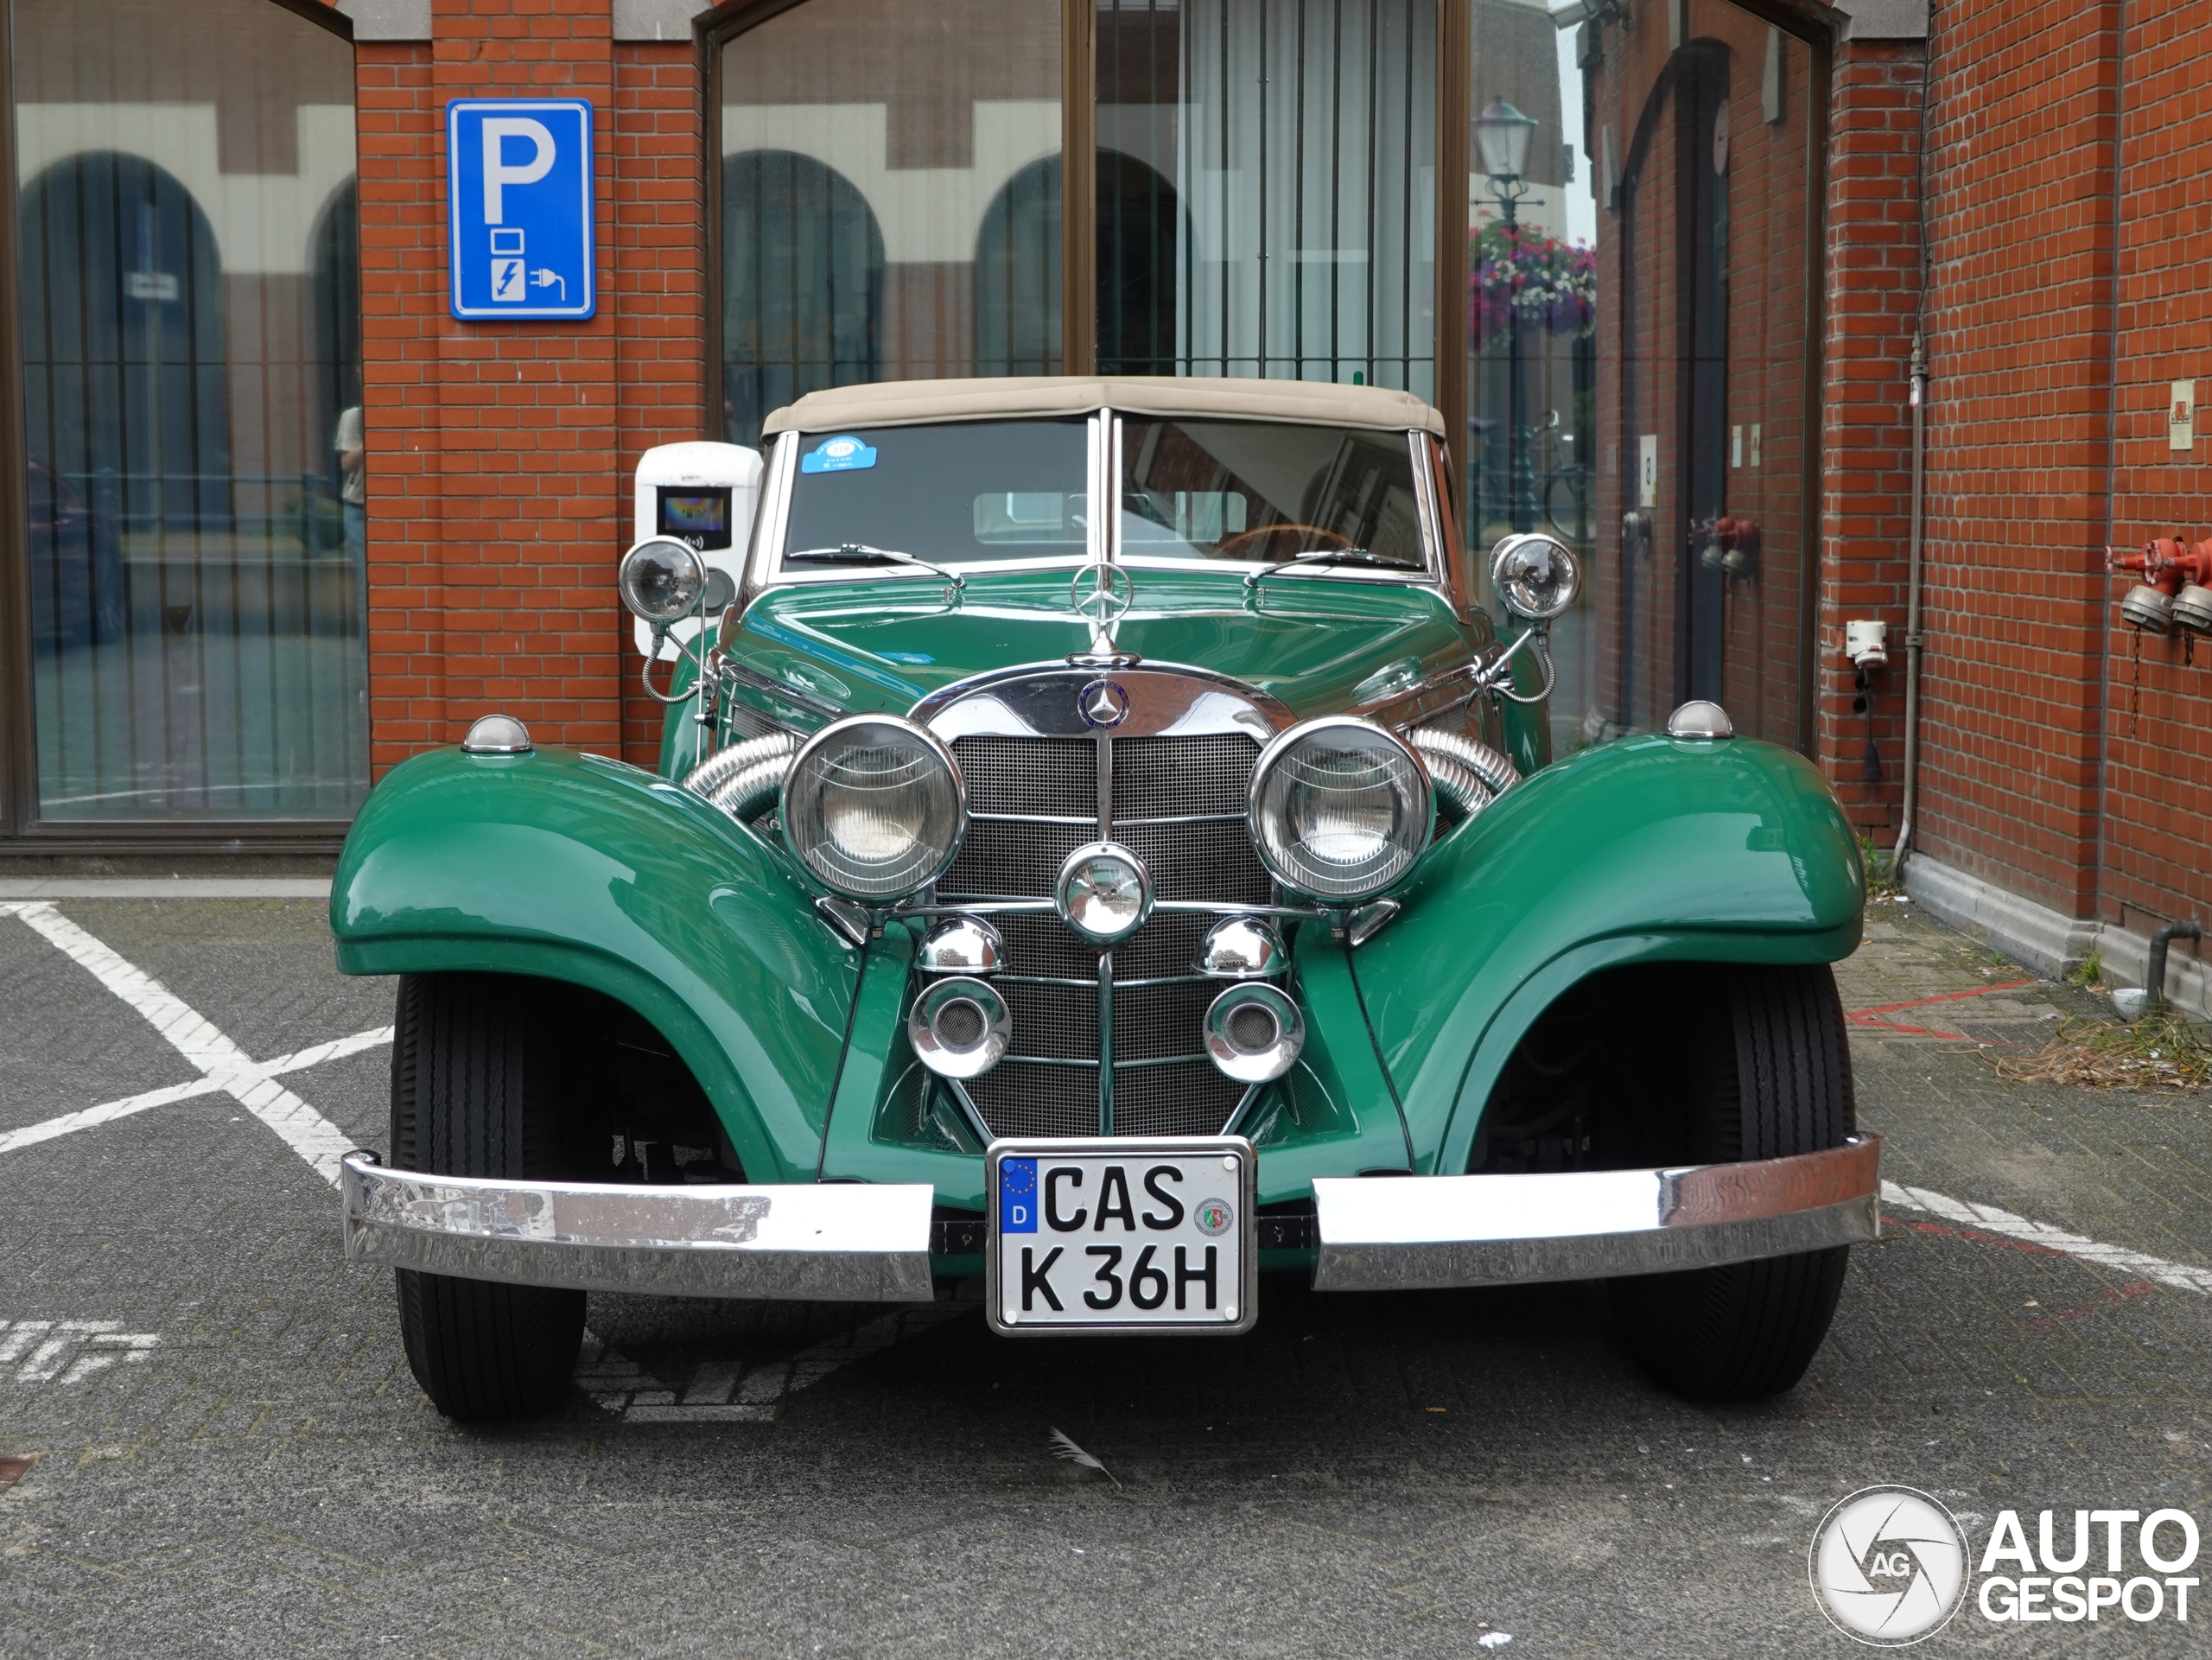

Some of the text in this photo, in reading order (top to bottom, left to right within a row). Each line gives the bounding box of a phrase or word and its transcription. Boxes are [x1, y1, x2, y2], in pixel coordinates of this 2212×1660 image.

[482, 118, 556, 225] P
[1088, 680, 1121, 691] MERCEDES
[1013, 1205, 1027, 1224] D
[1045, 1165, 1185, 1231] CAS
[1021, 1244, 1217, 1311] K 36H
